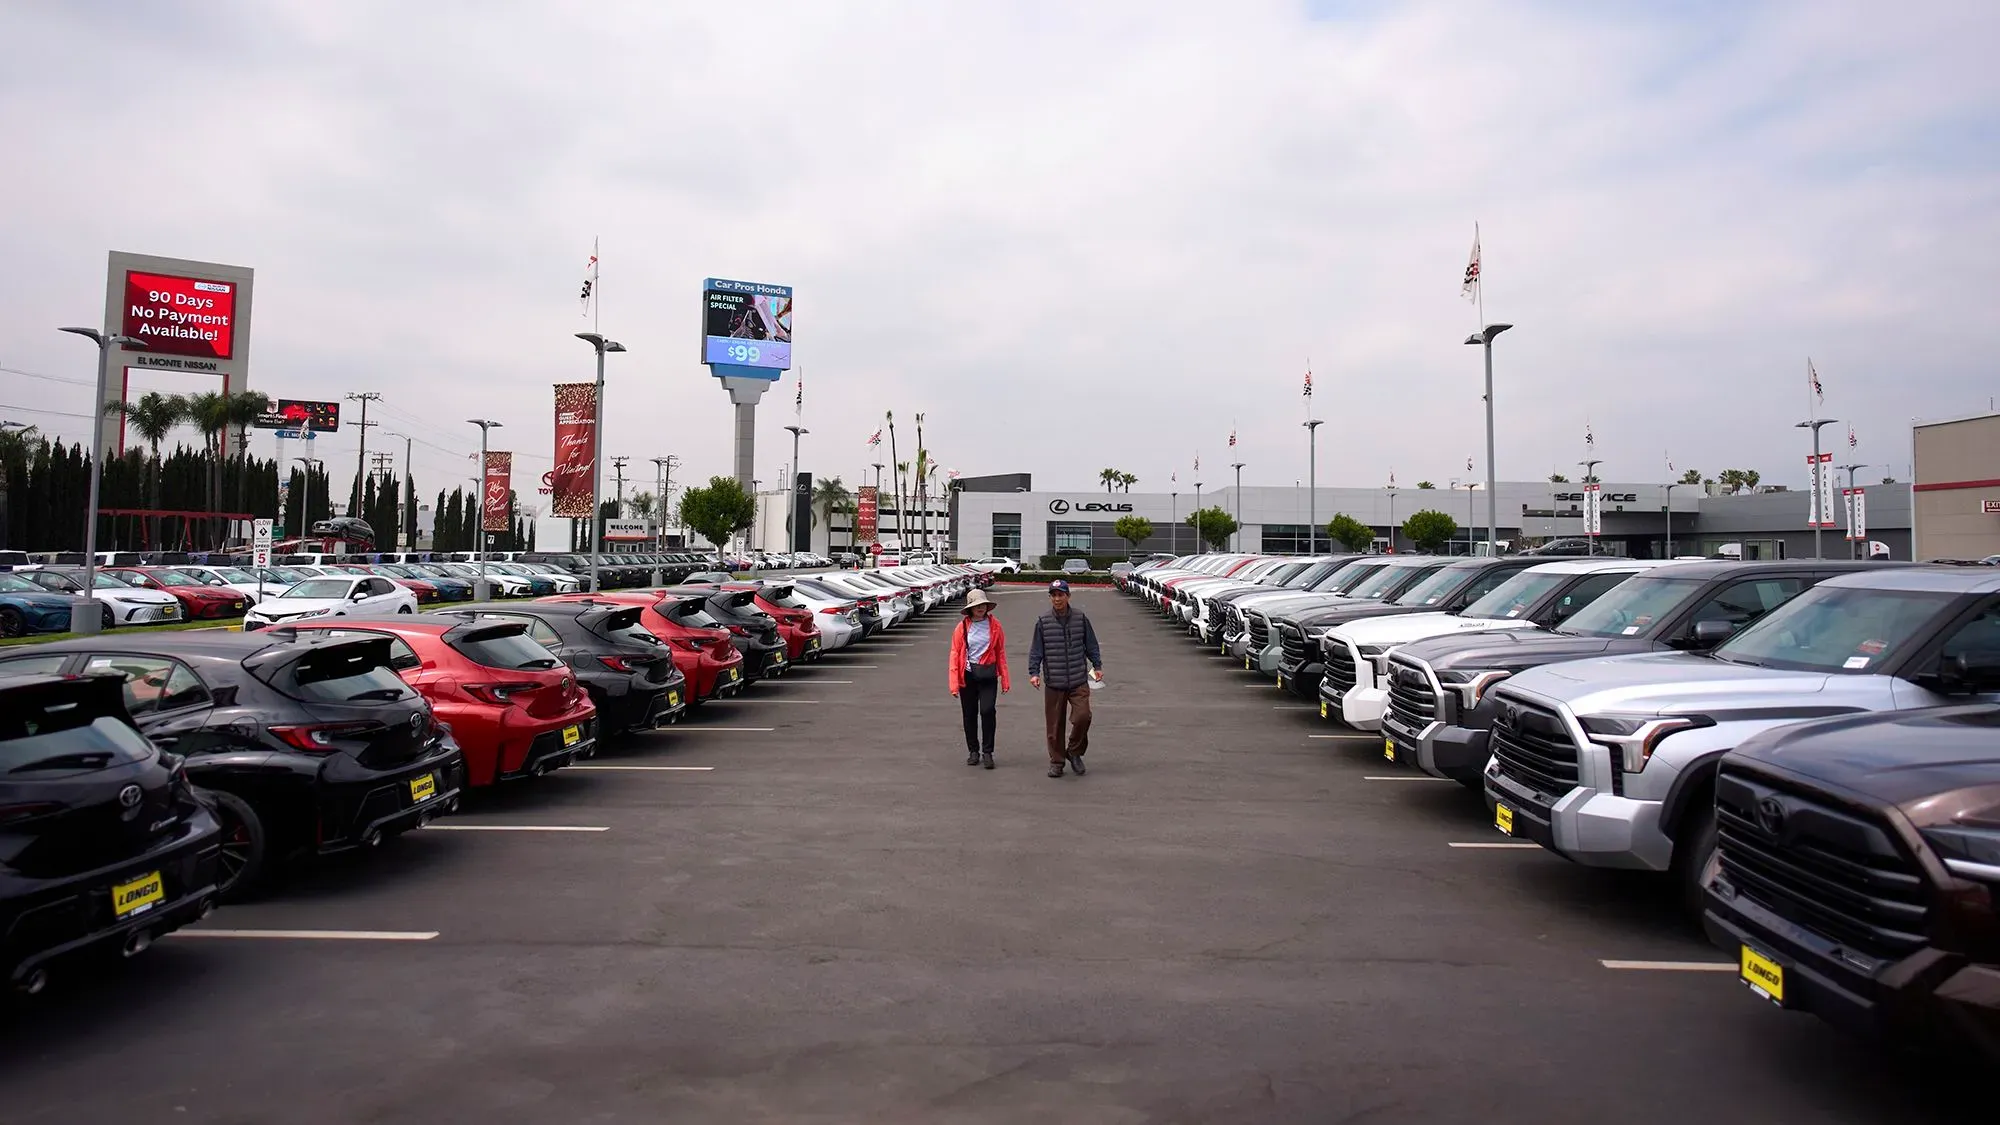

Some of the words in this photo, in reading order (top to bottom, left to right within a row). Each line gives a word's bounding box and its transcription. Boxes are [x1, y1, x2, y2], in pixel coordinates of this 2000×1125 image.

[715, 281, 732, 289] Car
[734, 283, 755, 291] Pros
[757, 285, 787, 295] Honda
[149, 290, 171, 303] 90
[175, 294, 214, 309] Days
[710, 302, 736, 310] SPECIAL
[723, 295, 743, 303] FILTER
[131, 305, 155, 318] No
[159, 308, 229, 325] Payment
[139, 323, 219, 340] Available!
[728, 345, 760, 363] $99
[137, 356, 147, 364] EL
[149, 358, 182, 368] MONTE
[184, 361, 217, 370] NISSAN
[561, 432, 588, 448] Thanks
[1555, 493, 1636, 502] SEVICE
[1076, 503, 1133, 512] LEXUS
[258, 553, 266, 564] 5
[413, 781, 432, 794] LONGO
[118, 881, 159, 906] LONGO
[1747, 960, 1780, 986] LONGO
